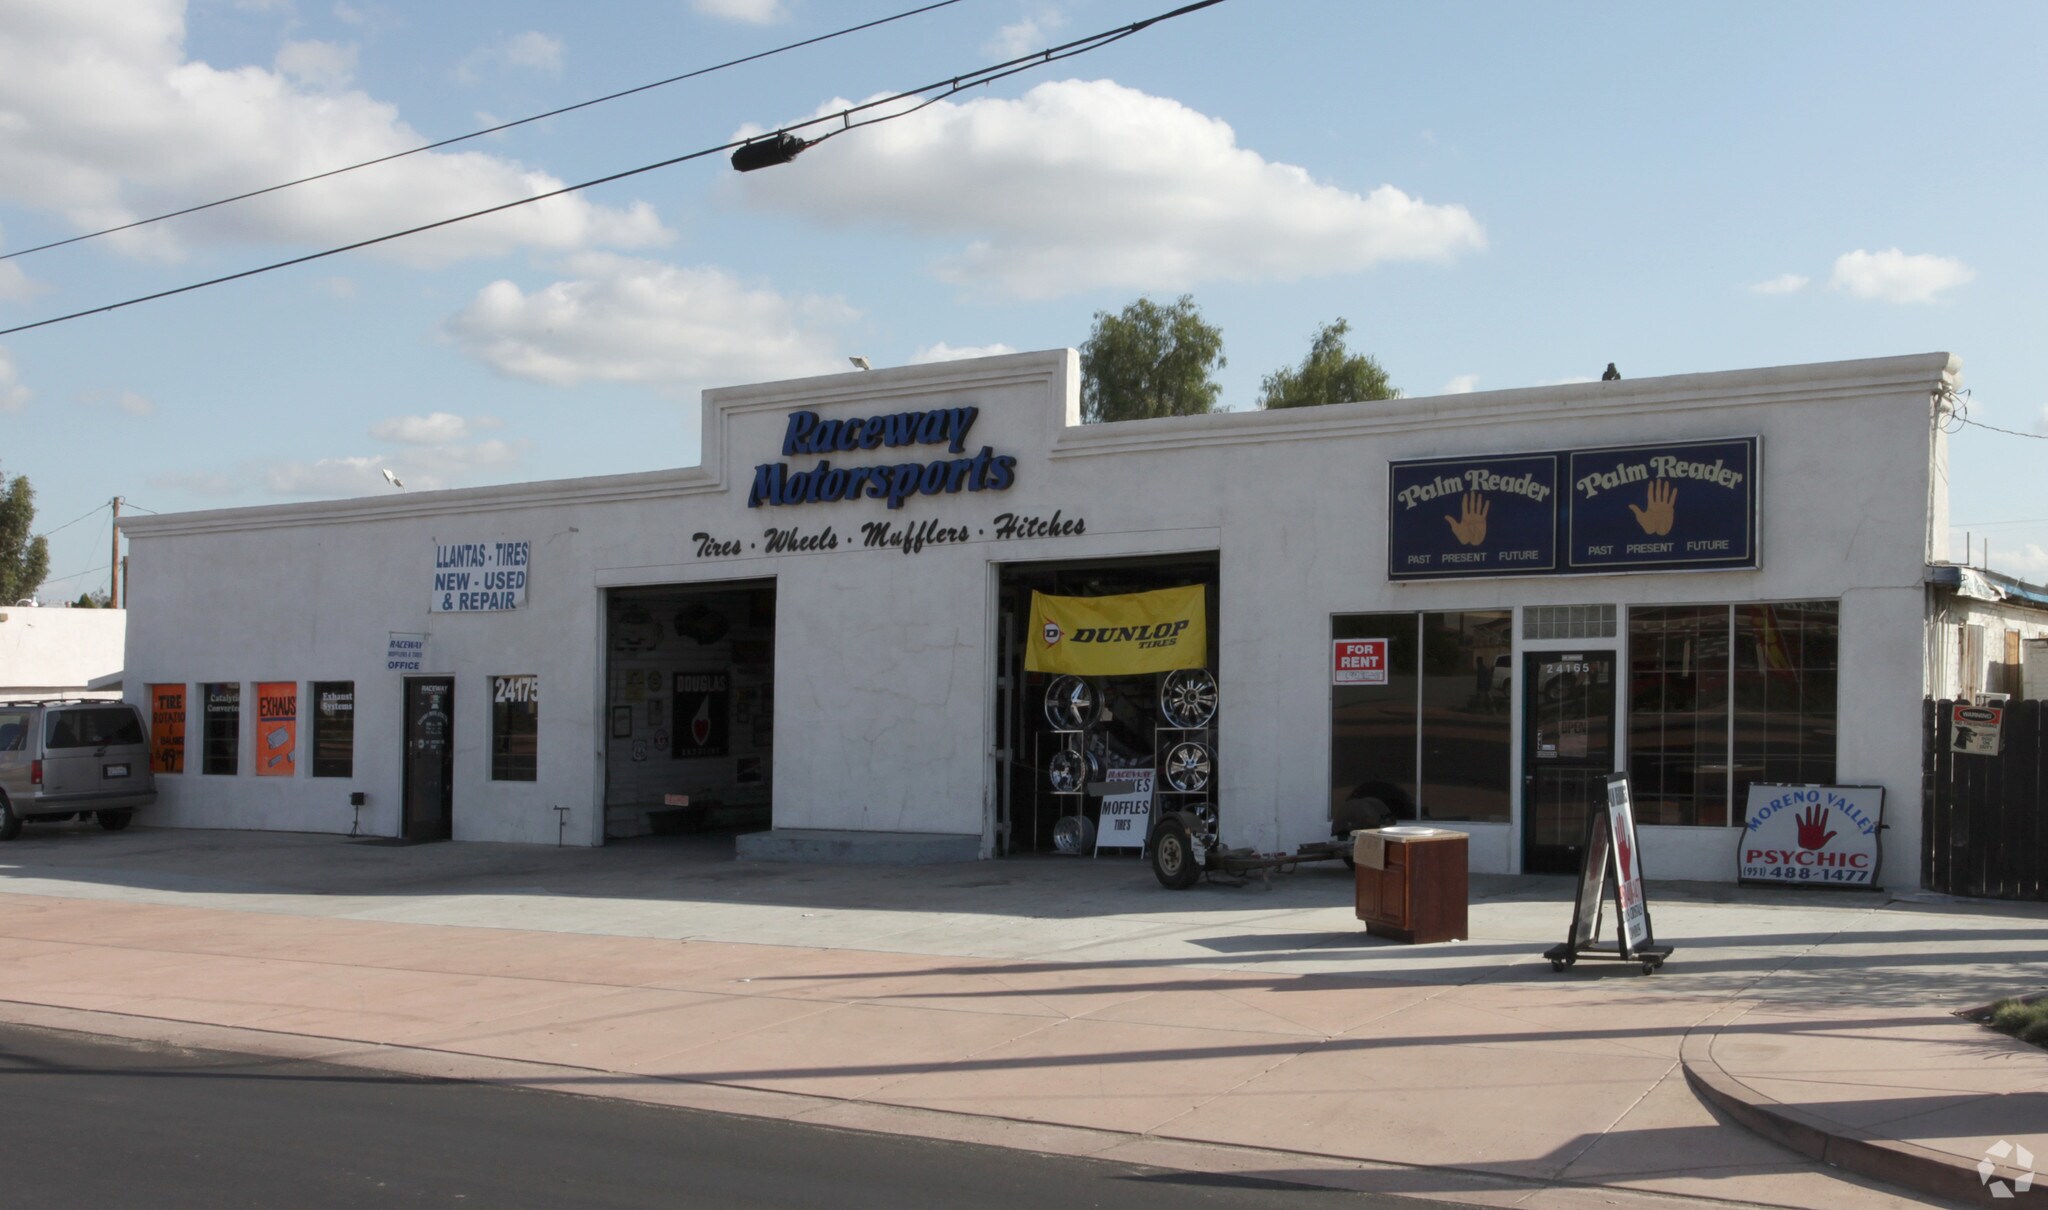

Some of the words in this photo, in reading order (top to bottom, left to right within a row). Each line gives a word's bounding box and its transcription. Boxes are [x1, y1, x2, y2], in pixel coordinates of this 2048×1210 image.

[782, 406, 979, 456] Raceway
[748, 445, 1017, 509] Motorsports
[1576, 463, 1649, 499] Palm
[1650, 455, 1743, 489] Reader
[1398, 476, 1463, 510] Palm
[1464, 469, 1550, 502] Reader
[692, 532, 742, 558] Tires
[764, 526, 838, 553] Wheels
[861, 518, 970, 555] Mufflers
[993, 509, 1086, 540] Hitches
[436, 544, 485, 568] LLANTAS
[495, 542, 528, 566] TIRES
[1588, 545, 1614, 556] PAST
[1626, 542, 1674, 554] PRESENT
[1687, 540, 1729, 551] FUTURE
[1408, 555, 1431, 564] PAST
[1441, 552, 1487, 563] PRESENT
[1499, 550, 1539, 561] FUTURE
[434, 572, 470, 591] NEW
[484, 570, 525, 590] USED
[442, 592, 453, 610] &
[458, 591, 516, 610] REPAIR
[1070, 619, 1189, 643] DUNLOP
[389, 640, 424, 649] RACEWAY
[1138, 637, 1177, 649] TIRES
[1347, 645, 1373, 655] FOR
[388, 661, 420, 670] OFFICE
[1341, 656, 1379, 668] RENT
[1546, 663, 1589, 673] 24165
[495, 677, 538, 702] 24175
[677, 675, 726, 693] DOUGLAS
[158, 694, 182, 709] TIRE
[322, 692, 353, 700] Exhaust
[322, 702, 353, 711] Systems
[1101, 800, 1149, 815] MOFFLES
[1748, 790, 1820, 832] MORENO
[1827, 793, 1875, 836] VALLEY
[1114, 819, 1131, 831] TIRES
[1746, 849, 1869, 868] PSYCHIC
[1743, 866, 1767, 877] (951)
[1769, 866, 1869, 881] 488-1477
